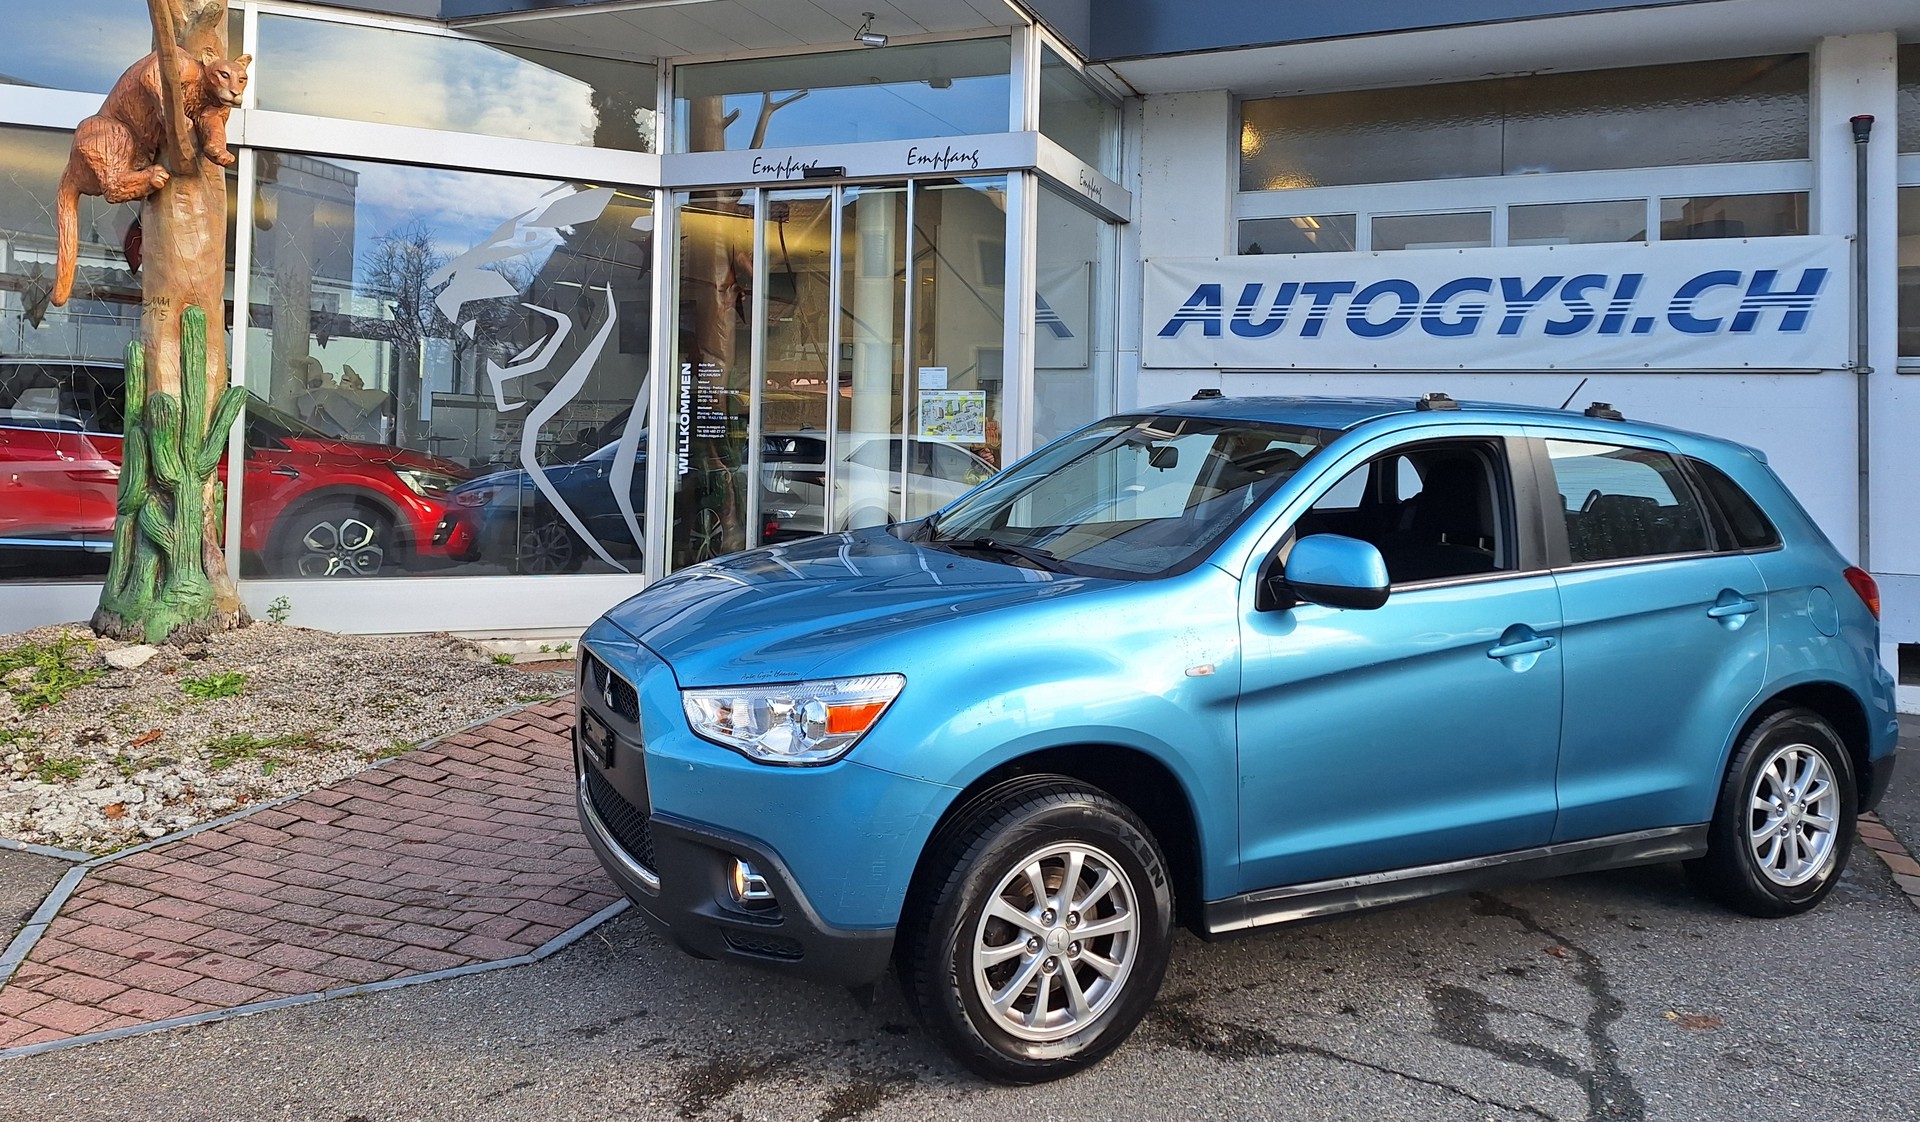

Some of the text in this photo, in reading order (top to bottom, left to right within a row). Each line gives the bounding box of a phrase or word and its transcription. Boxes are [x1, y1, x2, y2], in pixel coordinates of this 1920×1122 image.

[907, 145, 979, 170] Empfang
[1158, 268, 1829, 338] AUTOGYSI.CH
[679, 363, 691, 475] WILLKOMMEN
